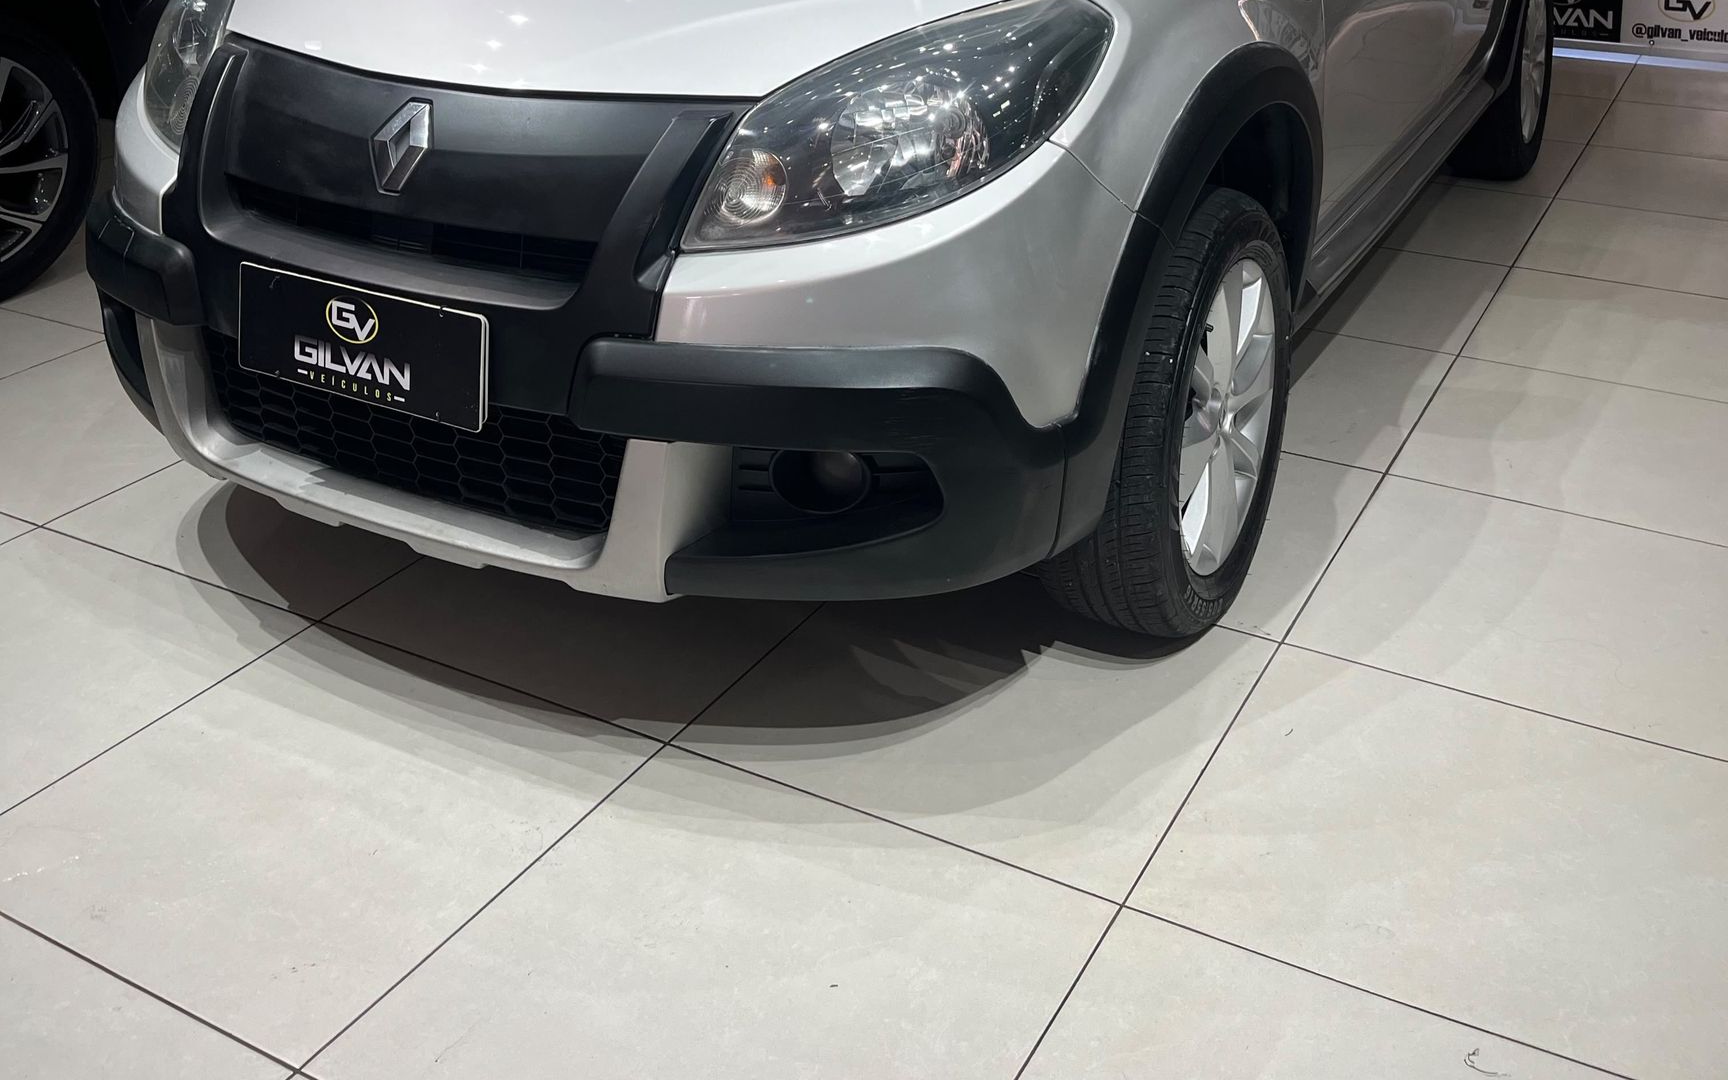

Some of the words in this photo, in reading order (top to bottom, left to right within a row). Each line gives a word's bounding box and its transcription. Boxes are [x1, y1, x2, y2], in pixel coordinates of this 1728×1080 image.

[1553, 7, 1613, 30] VAN
[331, 300, 376, 341] GV
[294, 334, 411, 391] GILVAN
